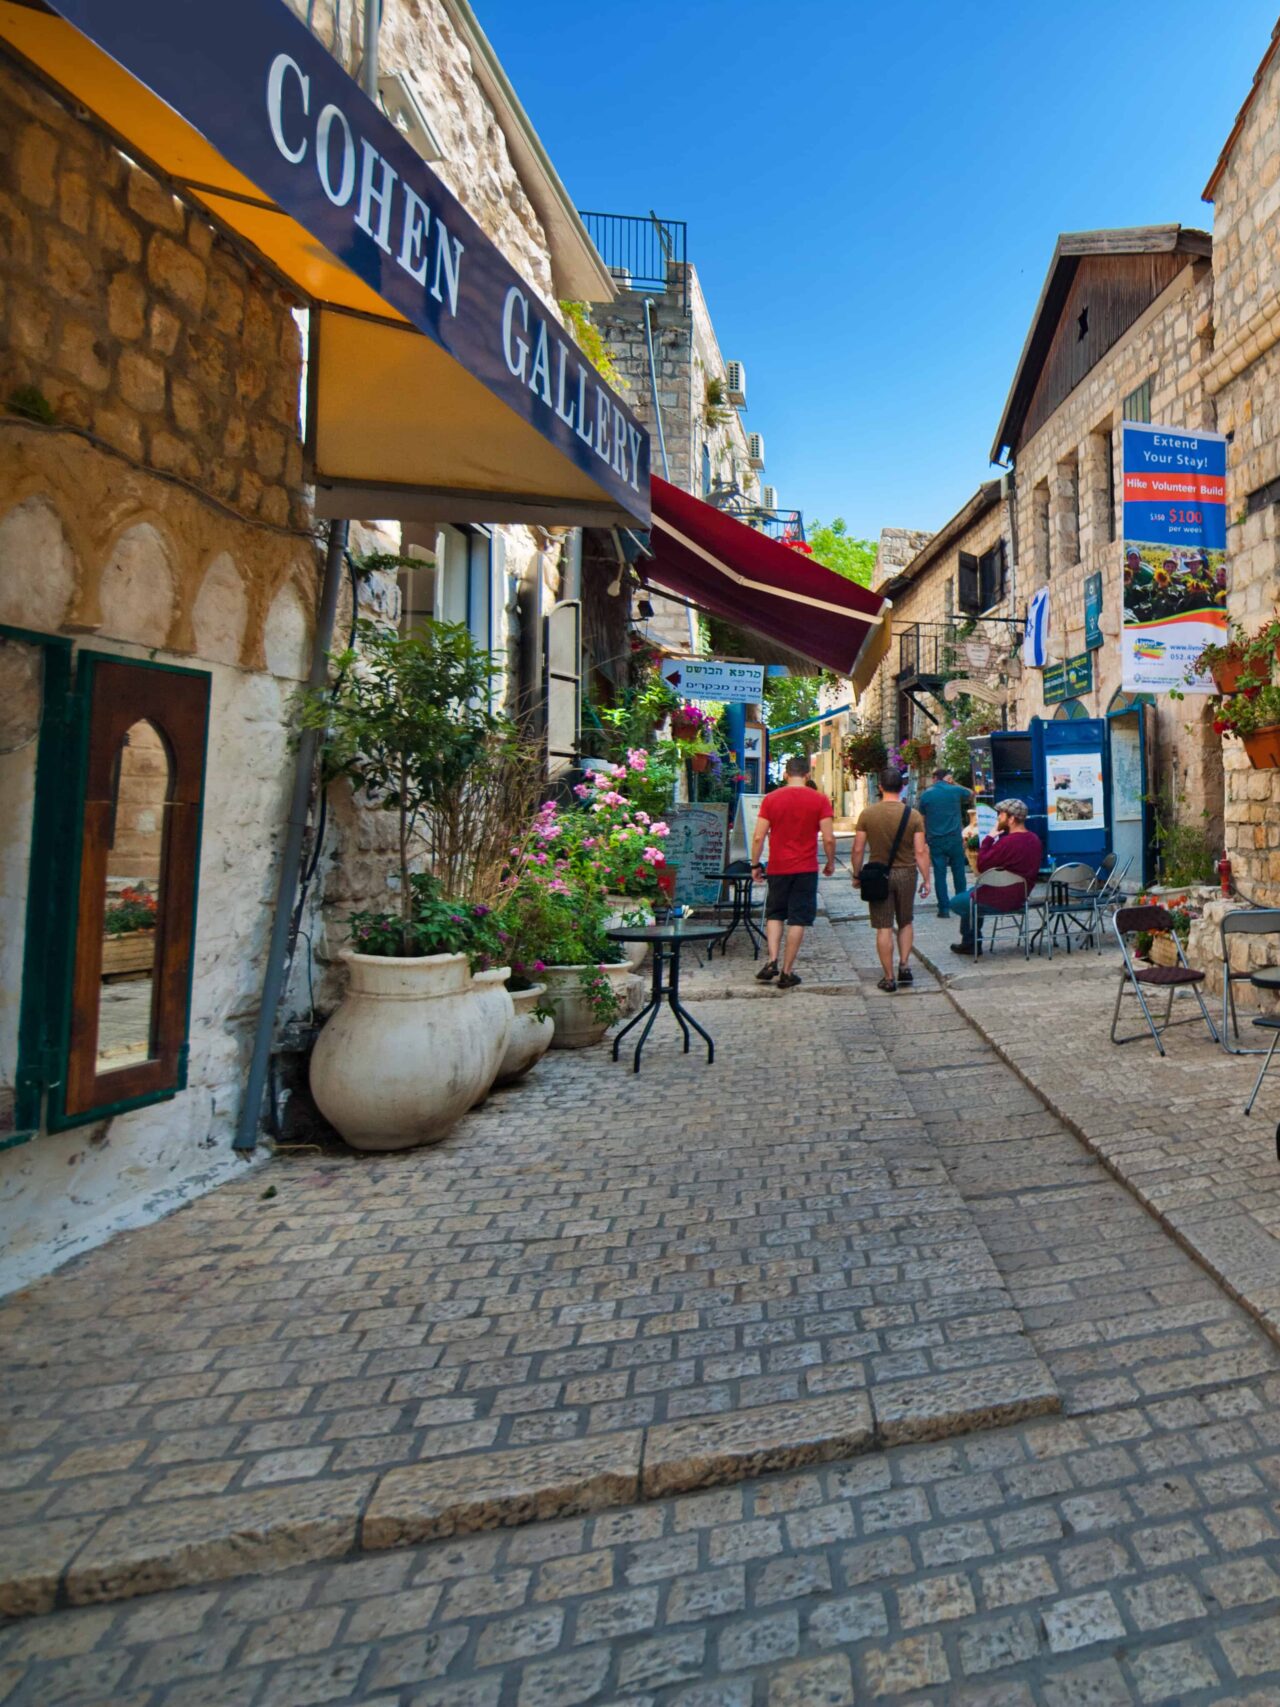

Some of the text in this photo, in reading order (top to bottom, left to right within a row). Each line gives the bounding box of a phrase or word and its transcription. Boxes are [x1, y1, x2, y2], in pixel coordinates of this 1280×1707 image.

[266, 53, 644, 493] COHEN GALLERY
[1153, 435, 1198, 450] Extend
[1143, 450, 1208, 470] Your Stay!
[1126, 478, 1224, 496] Hike Volunteer Build
[1169, 508, 1203, 524] $100
[685, 664, 762, 679] מרפא הבושם
[686, 681, 730, 691] מבקרים
[734, 685, 762, 693] מרכז
